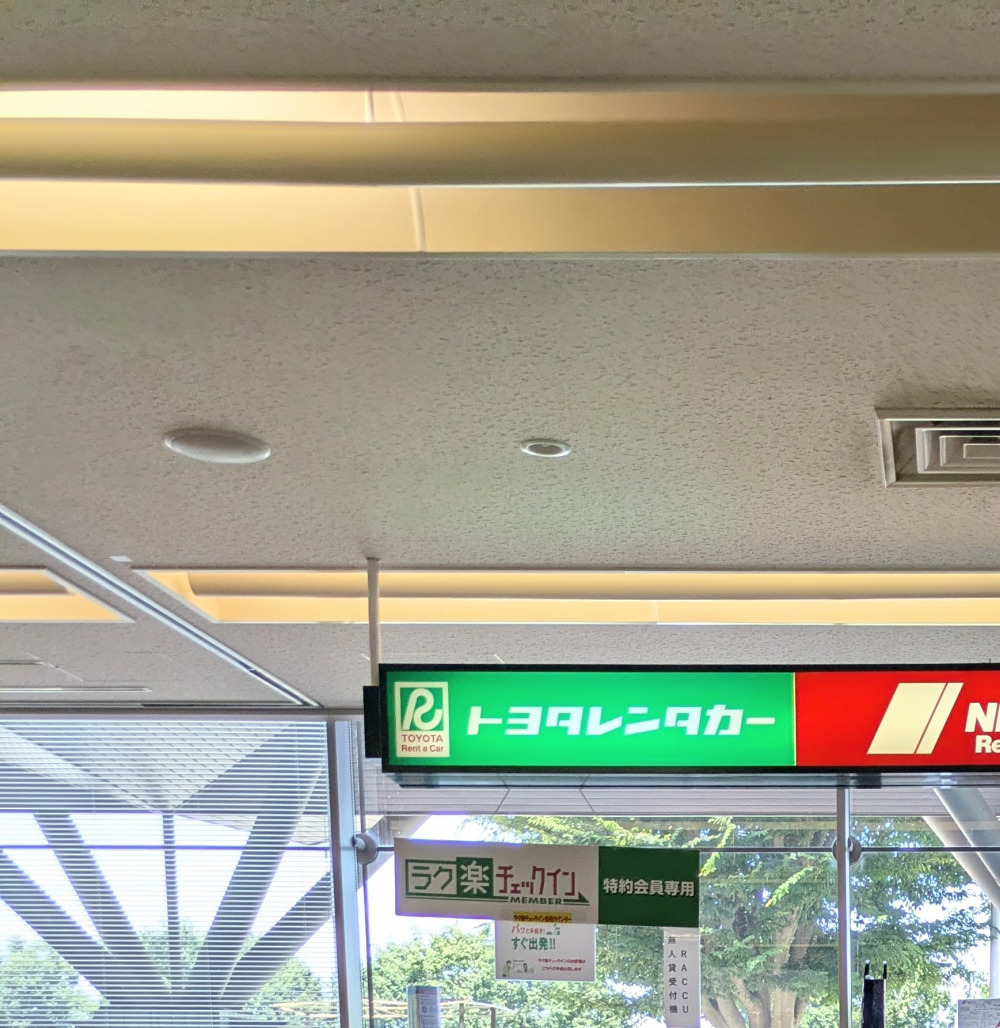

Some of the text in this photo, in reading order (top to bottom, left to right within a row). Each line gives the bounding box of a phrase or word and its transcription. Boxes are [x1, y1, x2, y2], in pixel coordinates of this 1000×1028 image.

[467, 705, 776, 735] トヨタレンタカー
[401, 734, 444, 743] TOYOTA
[401, 745, 421, 753] Rent
[428, 745, 444, 753] Car
[603, 877, 696, 898] 特約会員専用
[509, 896, 563, 906] MEMBER
[511, 936, 556, 950] すぐ出発!!
